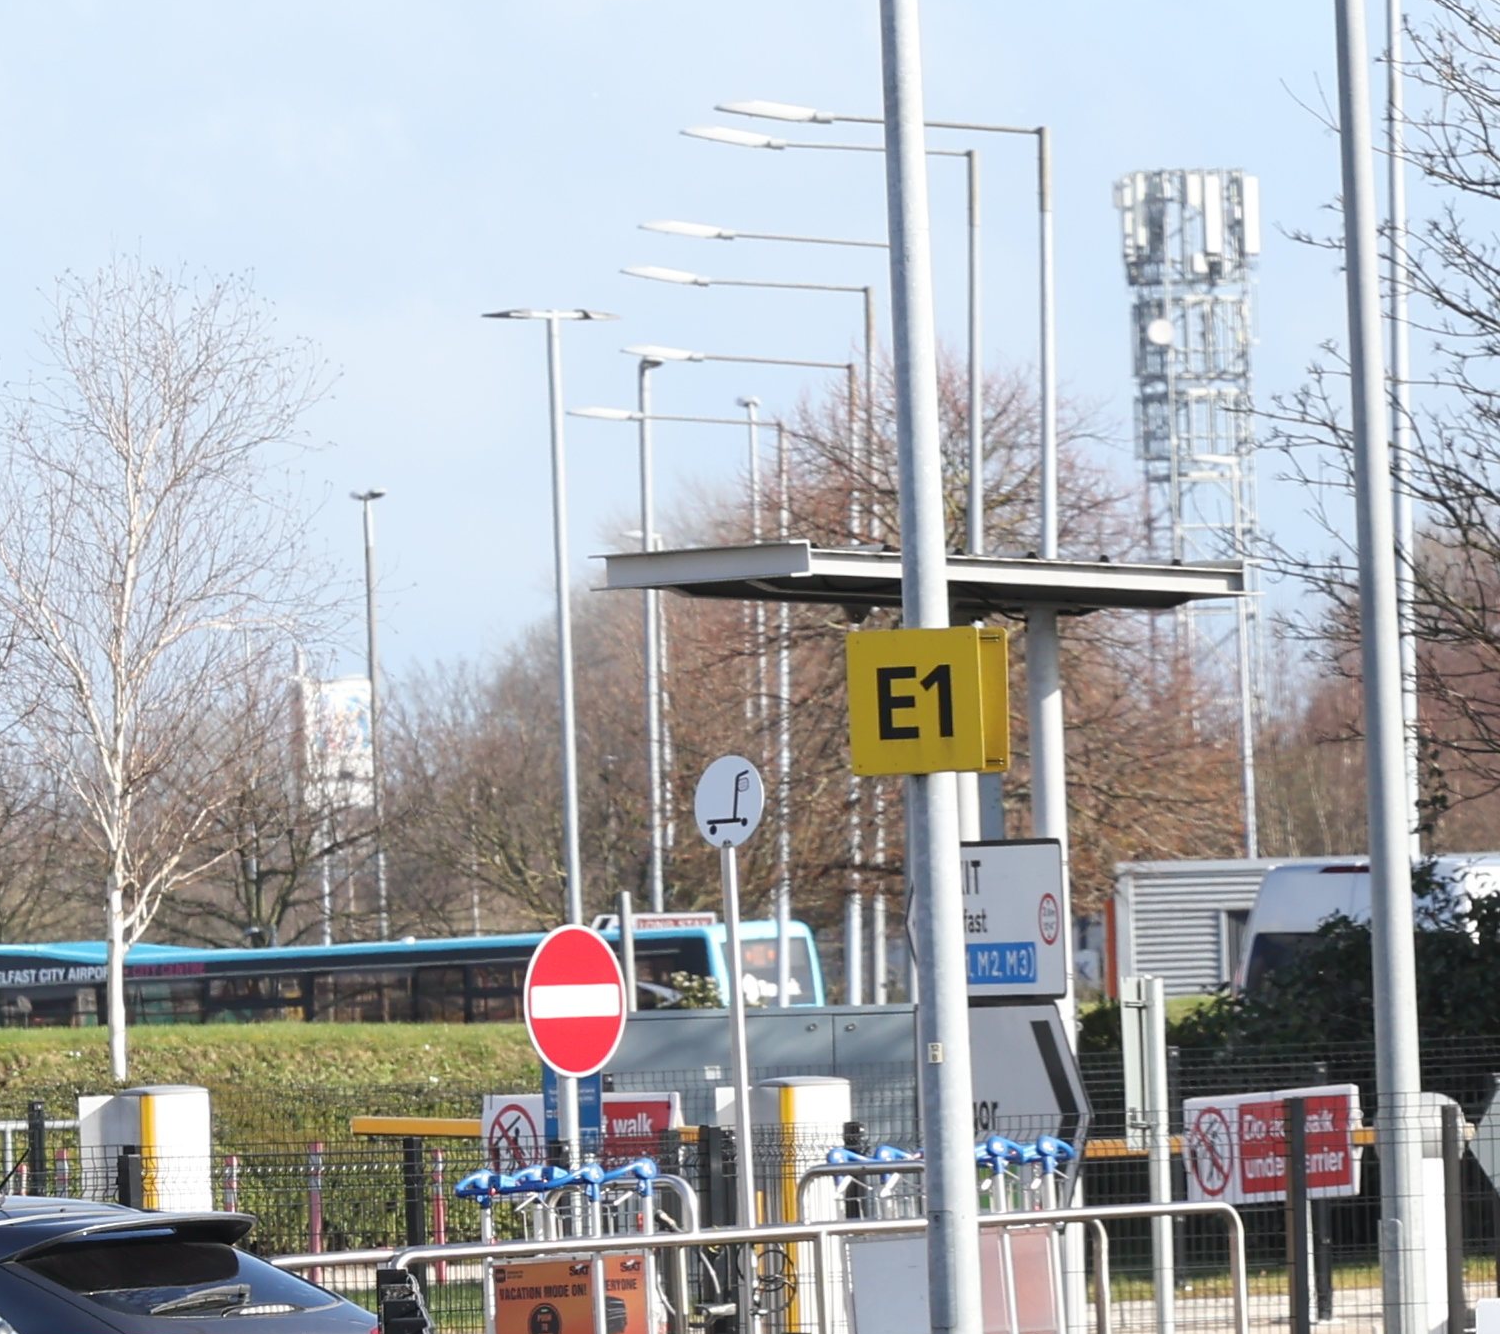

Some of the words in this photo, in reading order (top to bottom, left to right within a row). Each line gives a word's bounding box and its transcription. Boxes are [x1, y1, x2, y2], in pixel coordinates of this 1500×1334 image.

[876, 664, 954, 741] E1
[962, 860, 981, 895] IT
[964, 909, 988, 934] fast
[40, 968, 64, 983] CITY
[67, 966, 109, 982] AIRPOR
[1006, 946, 1036, 978] M3)
[613, 1113, 653, 1137] walk
[1245, 1151, 1285, 1179] unde
[1305, 1147, 1344, 1174] arrier
[499, 1285, 542, 1301] VACATION
[544, 1284, 569, 1299] MODE
[572, 1283, 587, 1296] ON!
[605, 1279, 637, 1292] ERYONE
